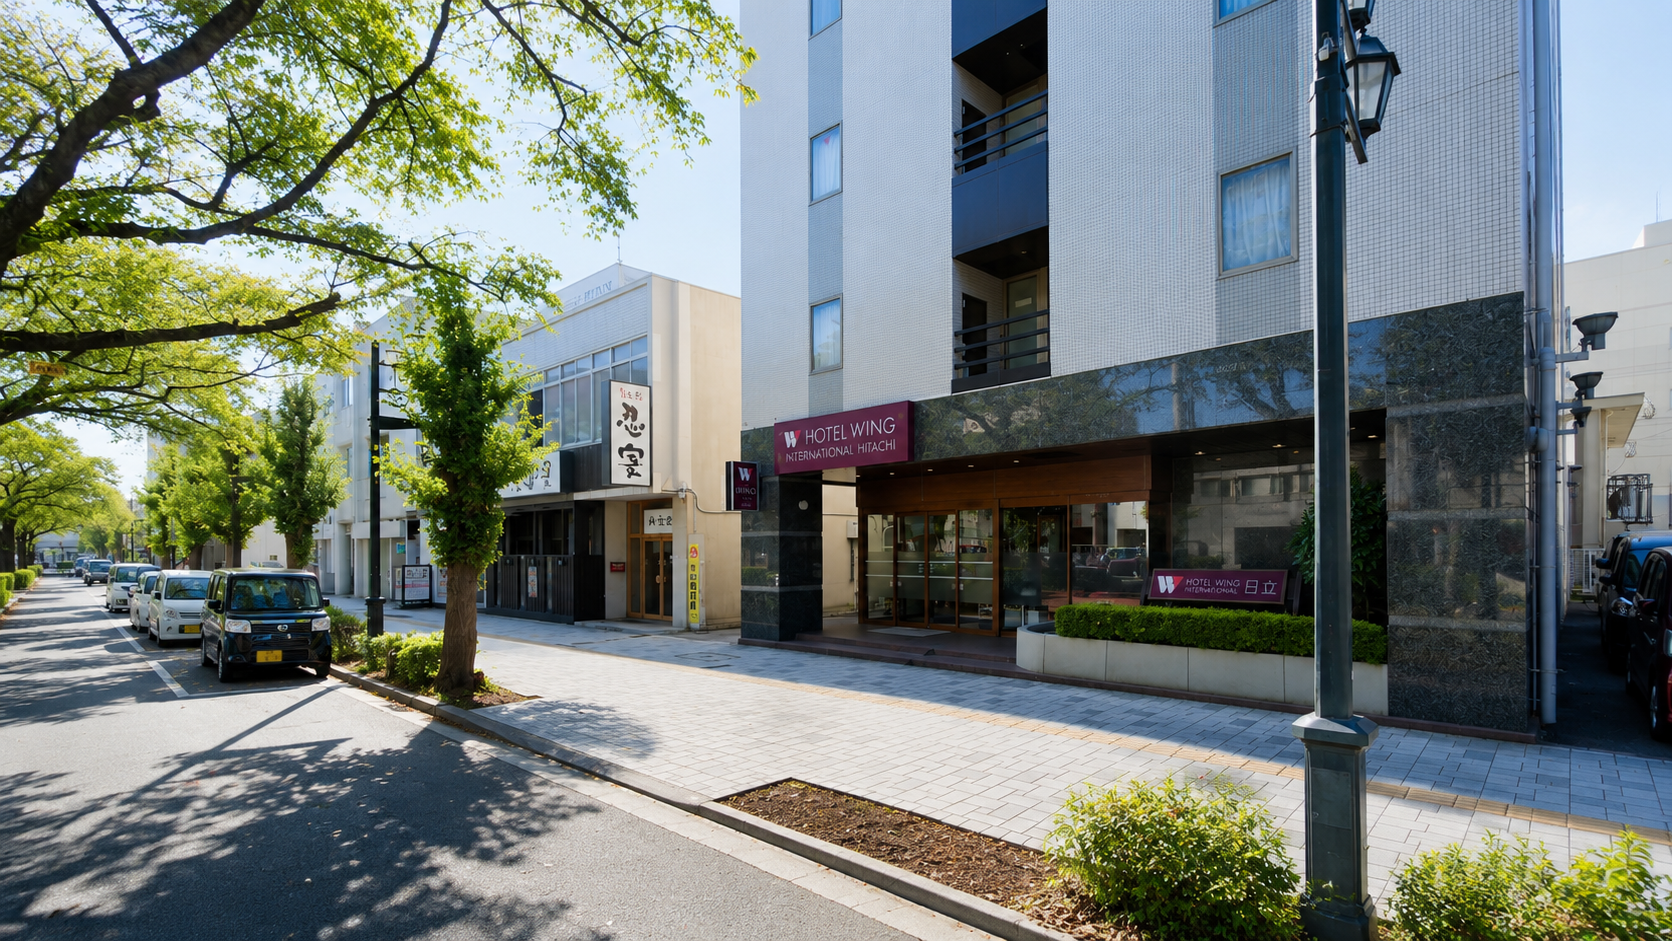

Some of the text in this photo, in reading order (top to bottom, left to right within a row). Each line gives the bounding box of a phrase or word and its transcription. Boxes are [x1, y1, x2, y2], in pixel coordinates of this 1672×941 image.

[805, 416, 896, 445] HOTEL WING
[785, 439, 896, 463] INTERNATIONAL HITACHI
[1185, 578, 1241, 588] HOTEL WING
[1244, 580, 1278, 595] 日立
